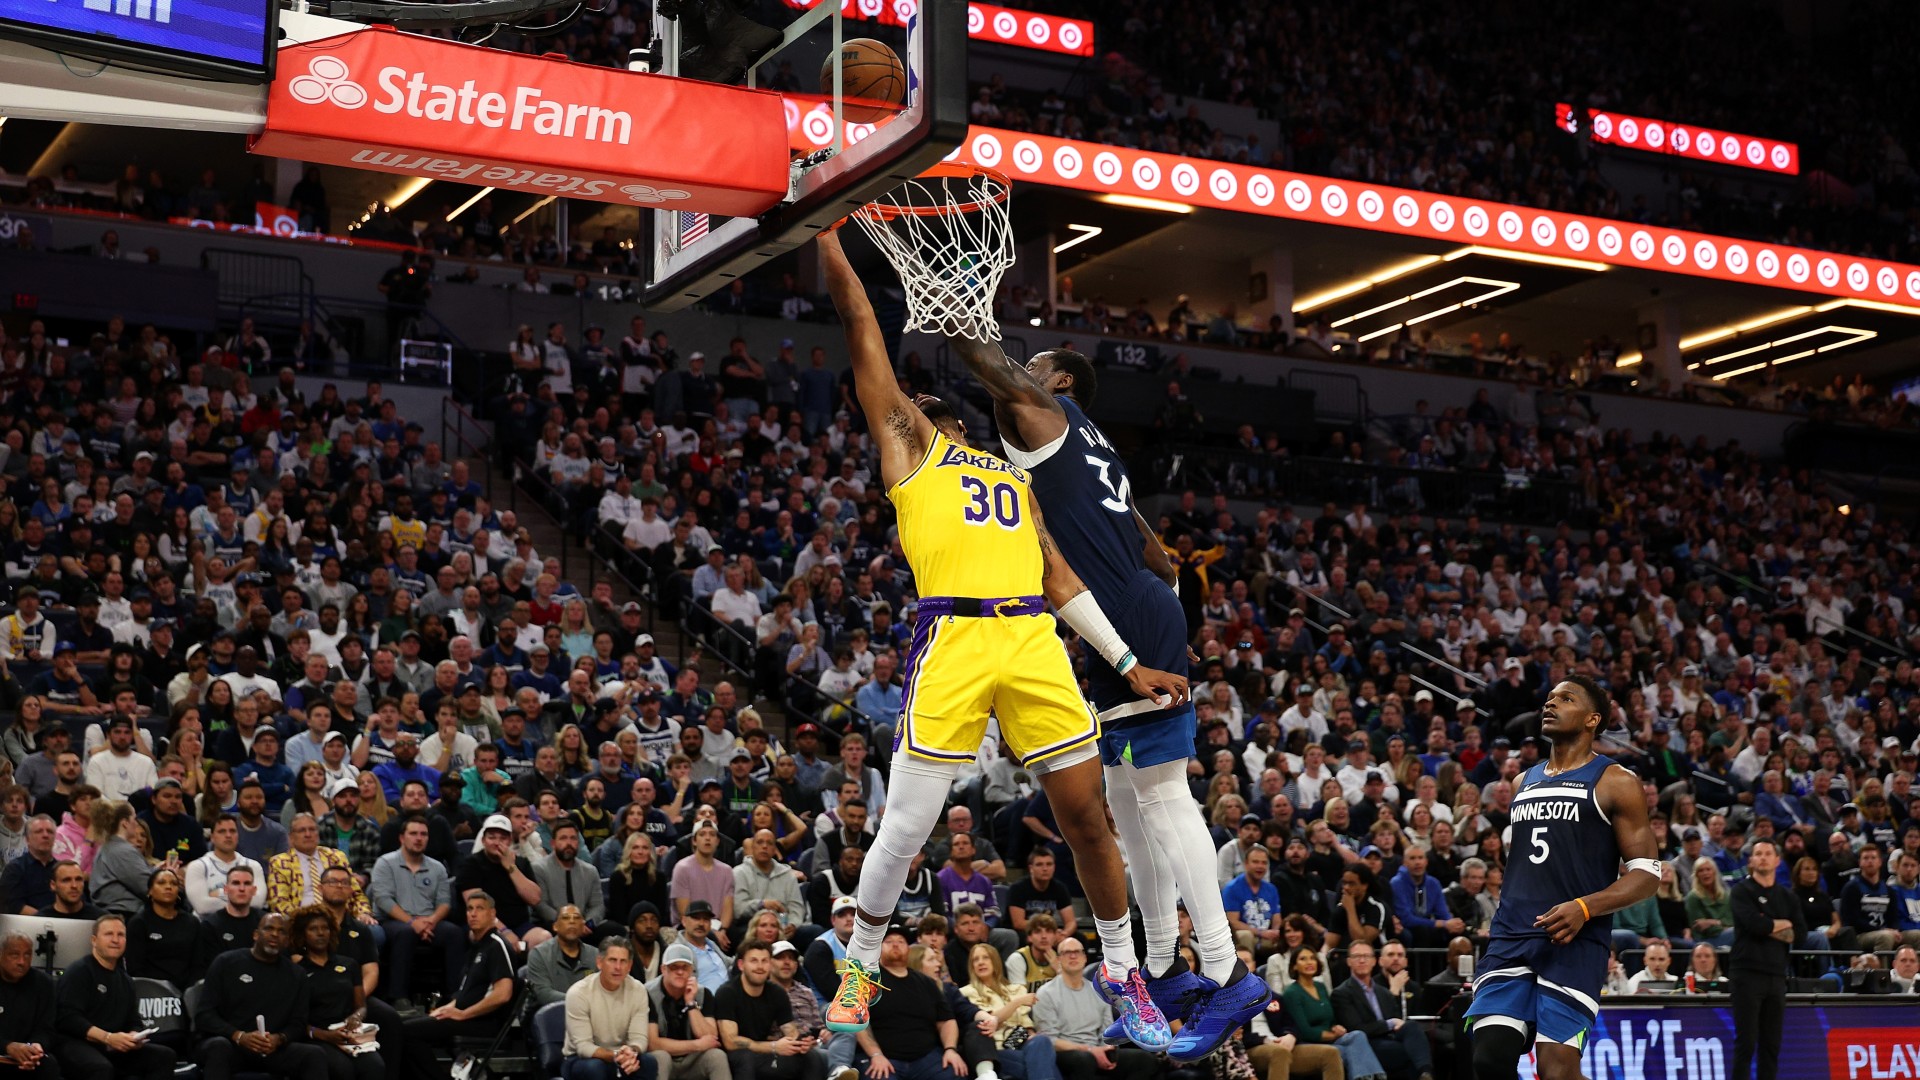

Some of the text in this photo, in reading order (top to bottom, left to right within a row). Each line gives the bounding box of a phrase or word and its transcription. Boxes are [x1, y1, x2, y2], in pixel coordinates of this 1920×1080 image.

[1114, 345, 1146, 365] 132
[960, 474, 1022, 530] 30
[1510, 801, 1580, 824] MINNESOTA
[1528, 826, 1550, 865] 5
[1652, 860, 1660, 872] 5
[137, 997, 182, 1018] AYOFFS
[1580, 1019, 1726, 1080] ick'Em
